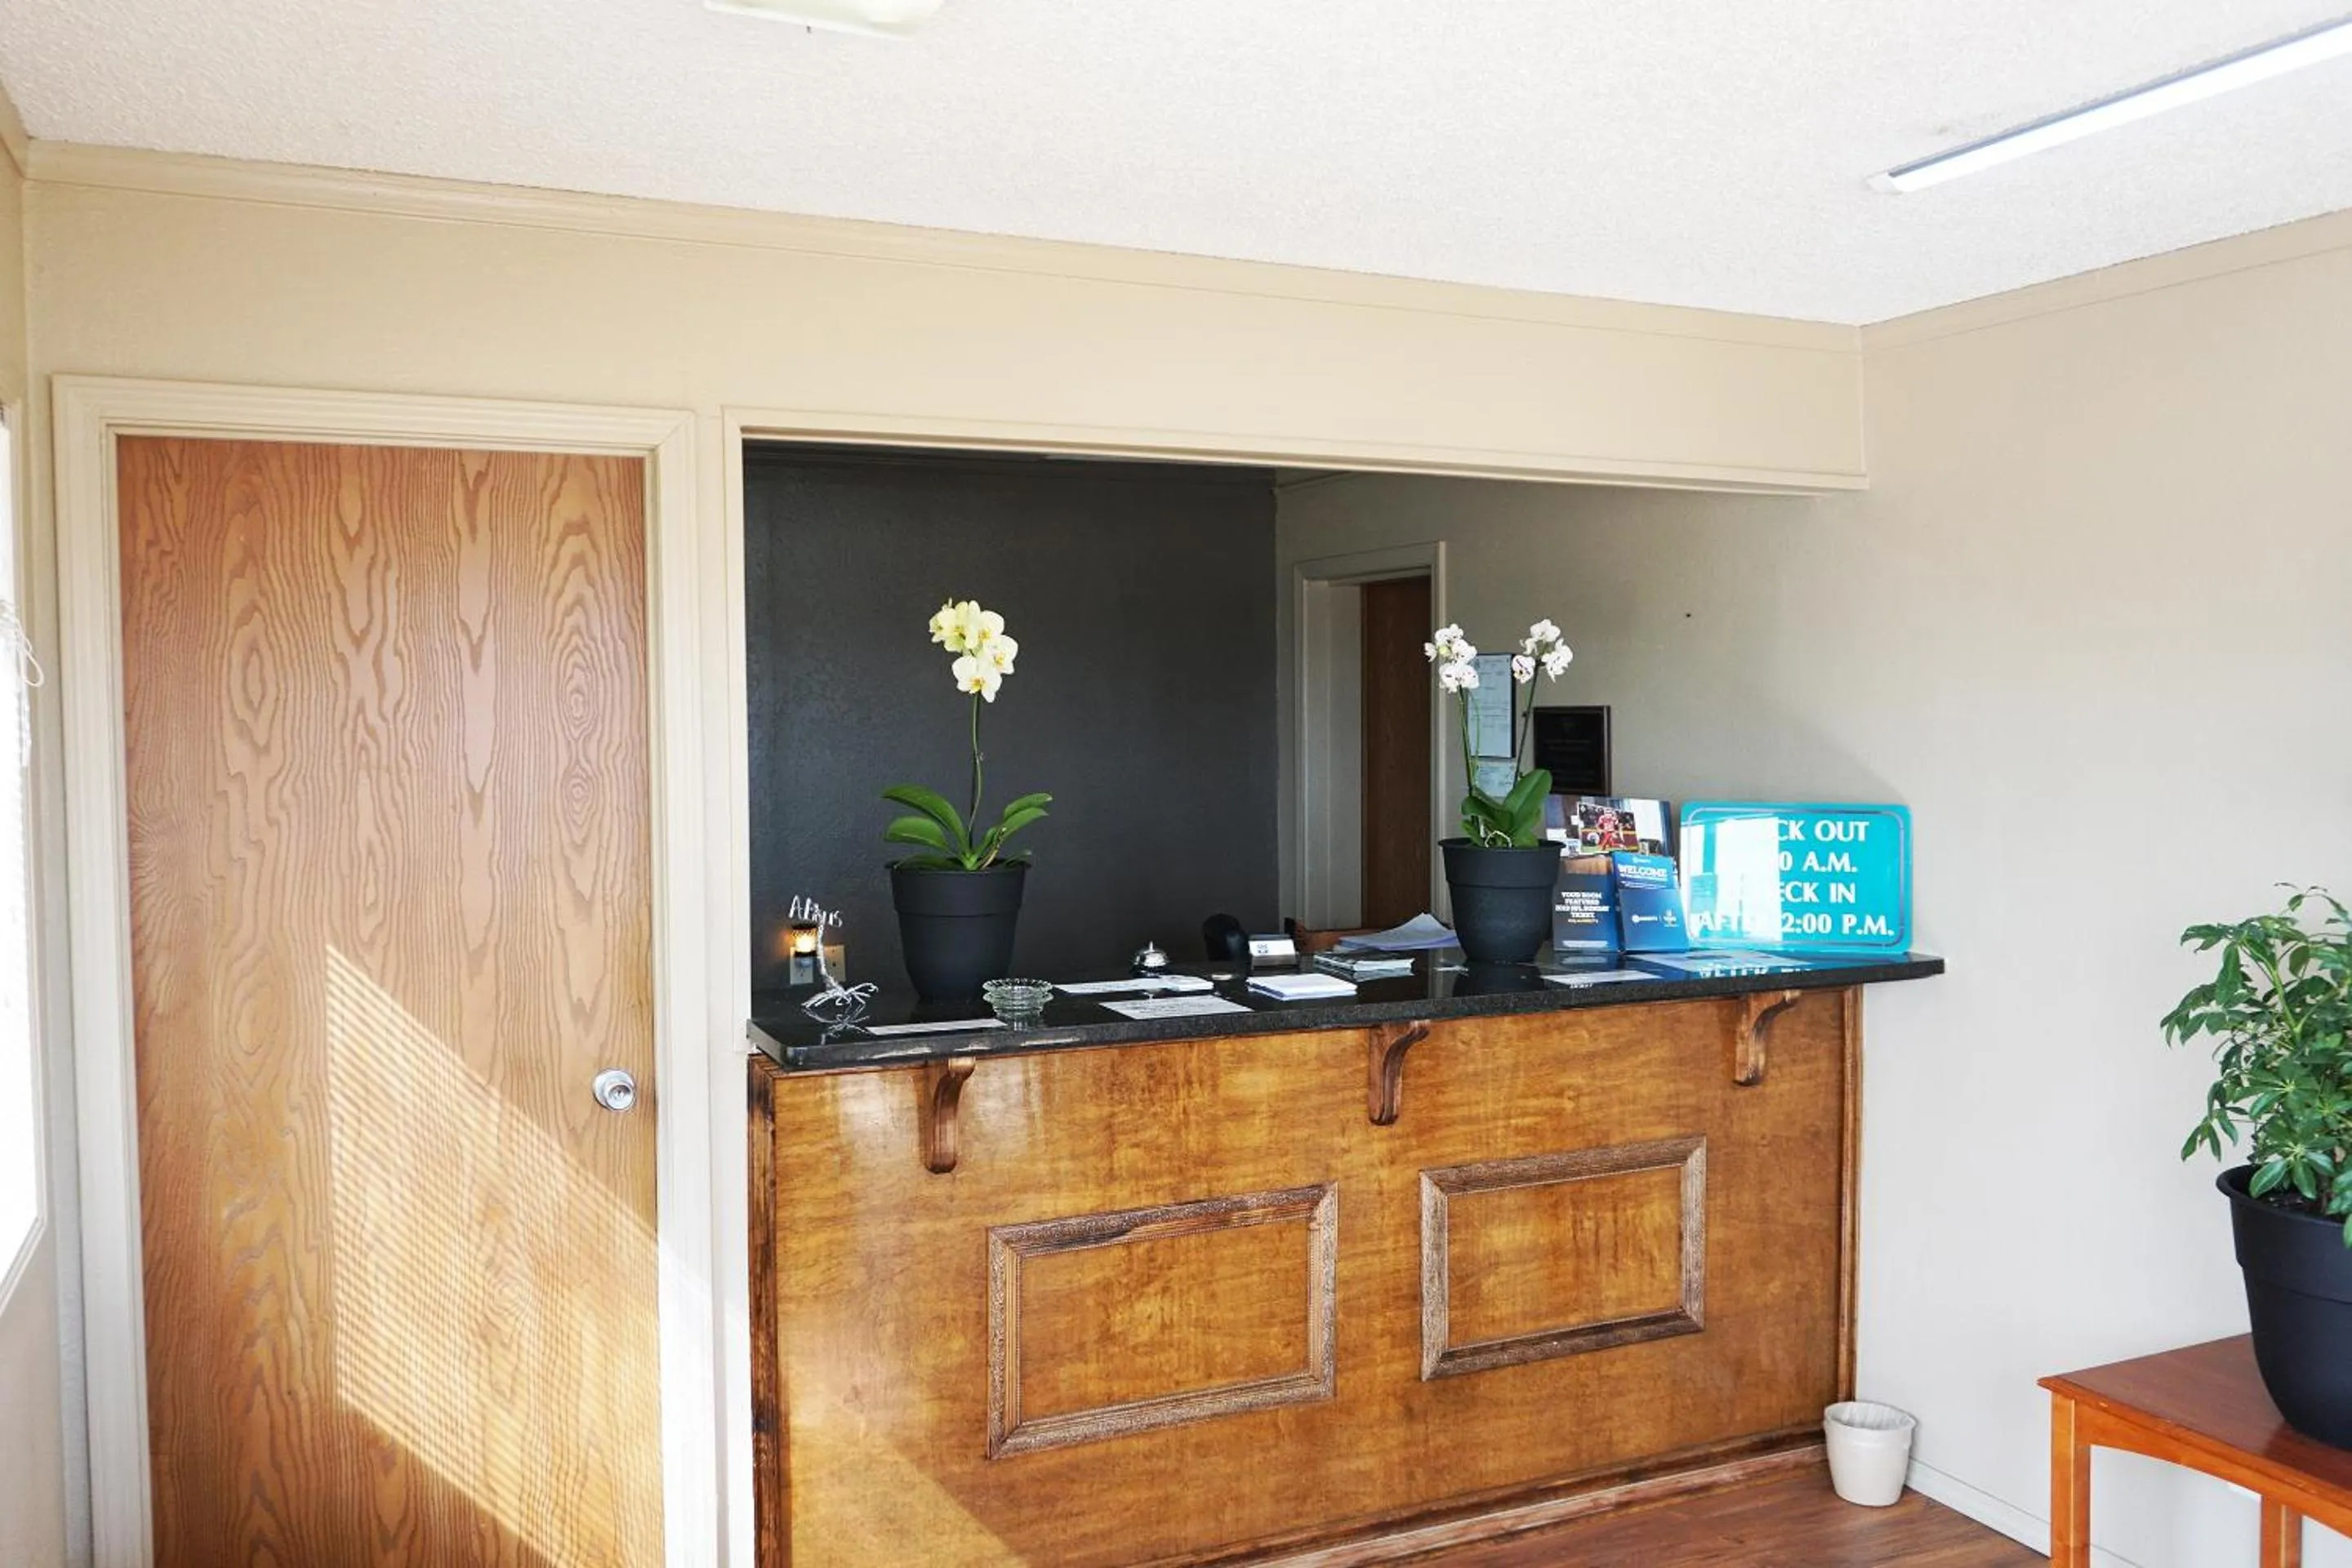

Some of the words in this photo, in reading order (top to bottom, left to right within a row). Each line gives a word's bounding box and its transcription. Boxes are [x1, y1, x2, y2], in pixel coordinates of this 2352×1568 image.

[1815, 820, 1869, 842] OUT
[1802, 851, 1858, 872] A.M.
[1829, 882, 1856, 904] IN
[1841, 913, 1895, 937] P.M.
